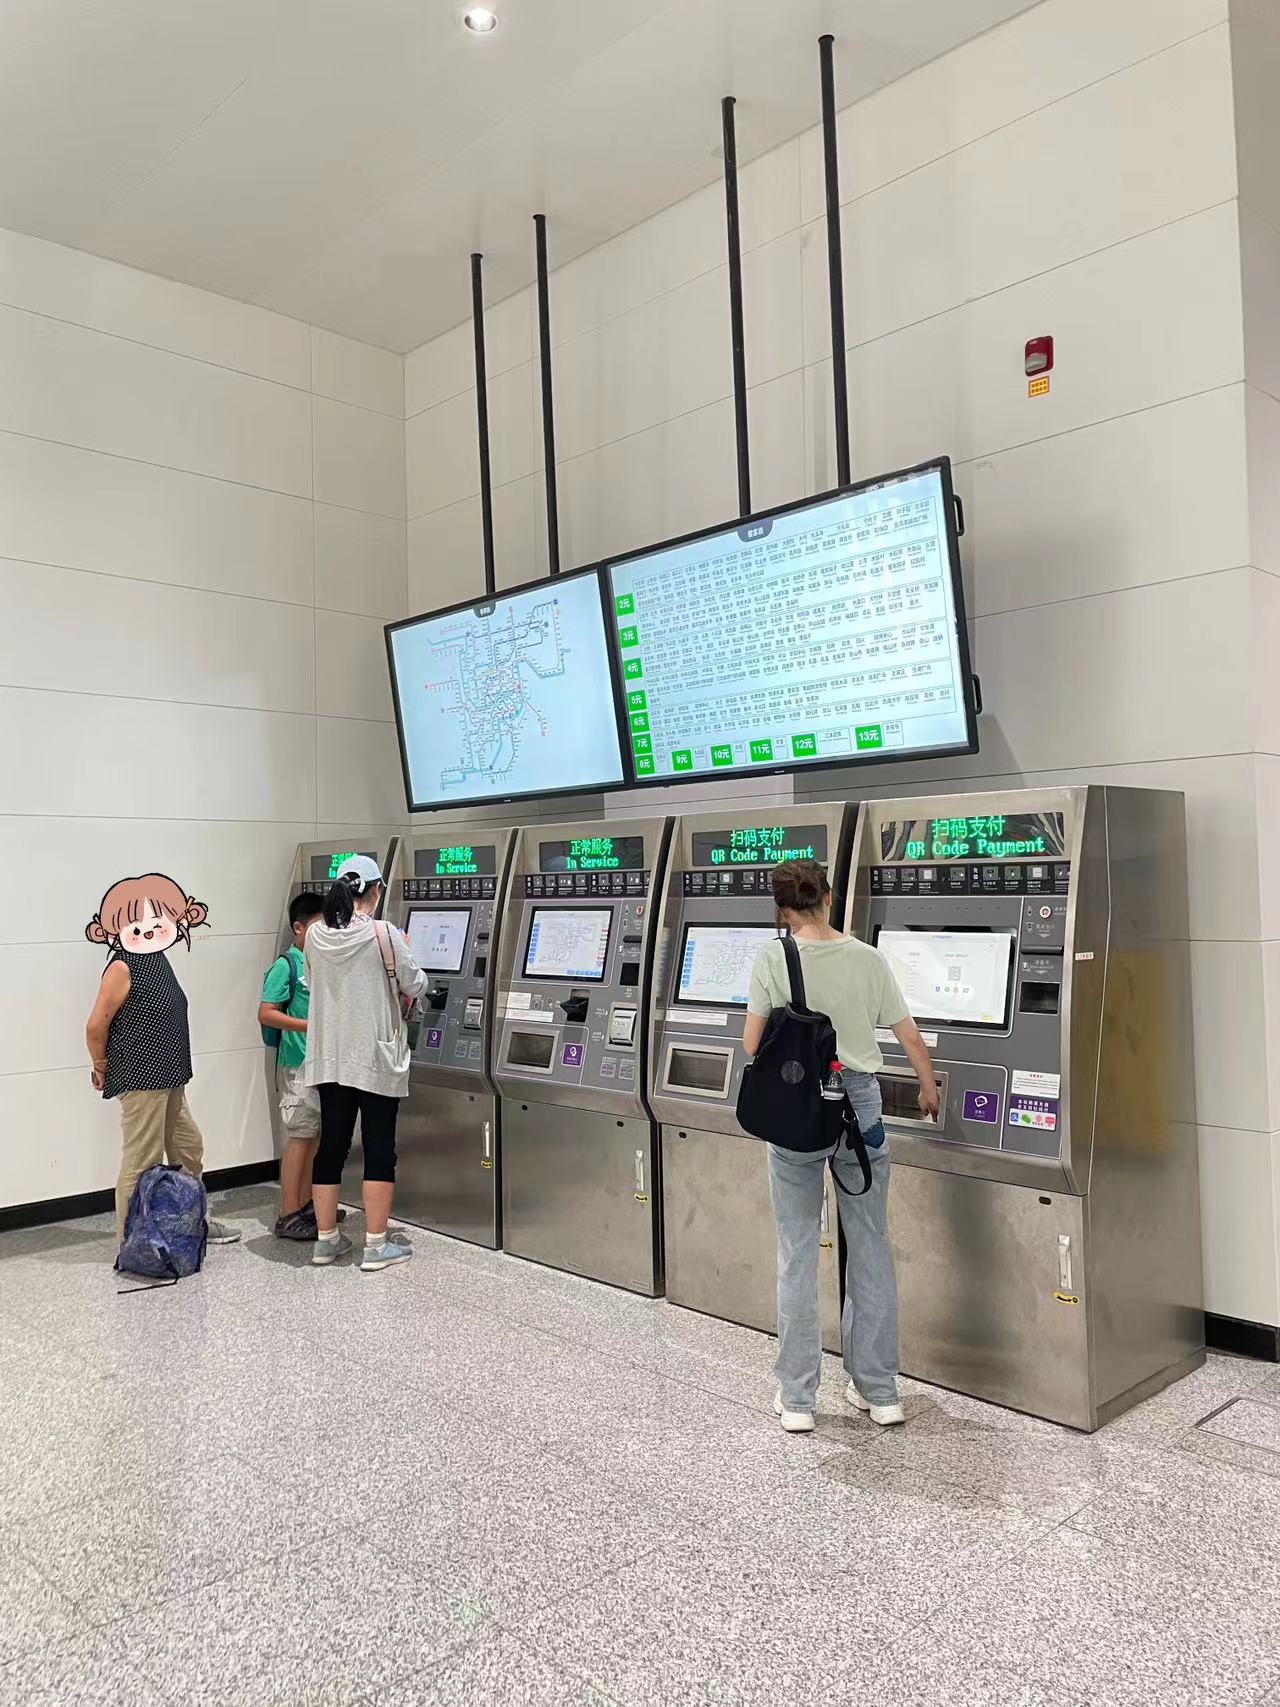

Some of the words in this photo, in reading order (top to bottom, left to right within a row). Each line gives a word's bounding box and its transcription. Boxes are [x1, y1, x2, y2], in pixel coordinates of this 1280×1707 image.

[619, 598, 630, 609] 2元
[623, 631, 634, 641] 3元
[627, 663, 638, 672] 4元
[632, 695, 642, 704] 5元
[634, 717, 645, 726] 6元
[858, 730, 879, 742] 13元
[637, 739, 648, 748] 7元
[795, 738, 814, 750] 12元
[713, 749, 729, 759] 10元
[753, 745, 770, 755] 11元
[639, 759, 650, 768] 8元
[676, 755, 688, 764] 9元
[932, 815, 1006, 839] 扫码支付
[730, 827, 785, 847] 扫码支付
[570, 838, 613, 856] 正常服务
[907, 841, 925, 858] QR
[932, 840, 969, 855] Code
[978, 837, 1045, 857] Payment
[438, 846, 474, 862] 正常服务
[711, 849, 725, 864] QR
[731, 848, 758, 862] Code
[764, 845, 814, 864] Payment
[436, 863, 445, 874] In
[447, 862, 477, 874] Service
[567, 858, 577, 869] In
[581, 856, 619, 868] Service
